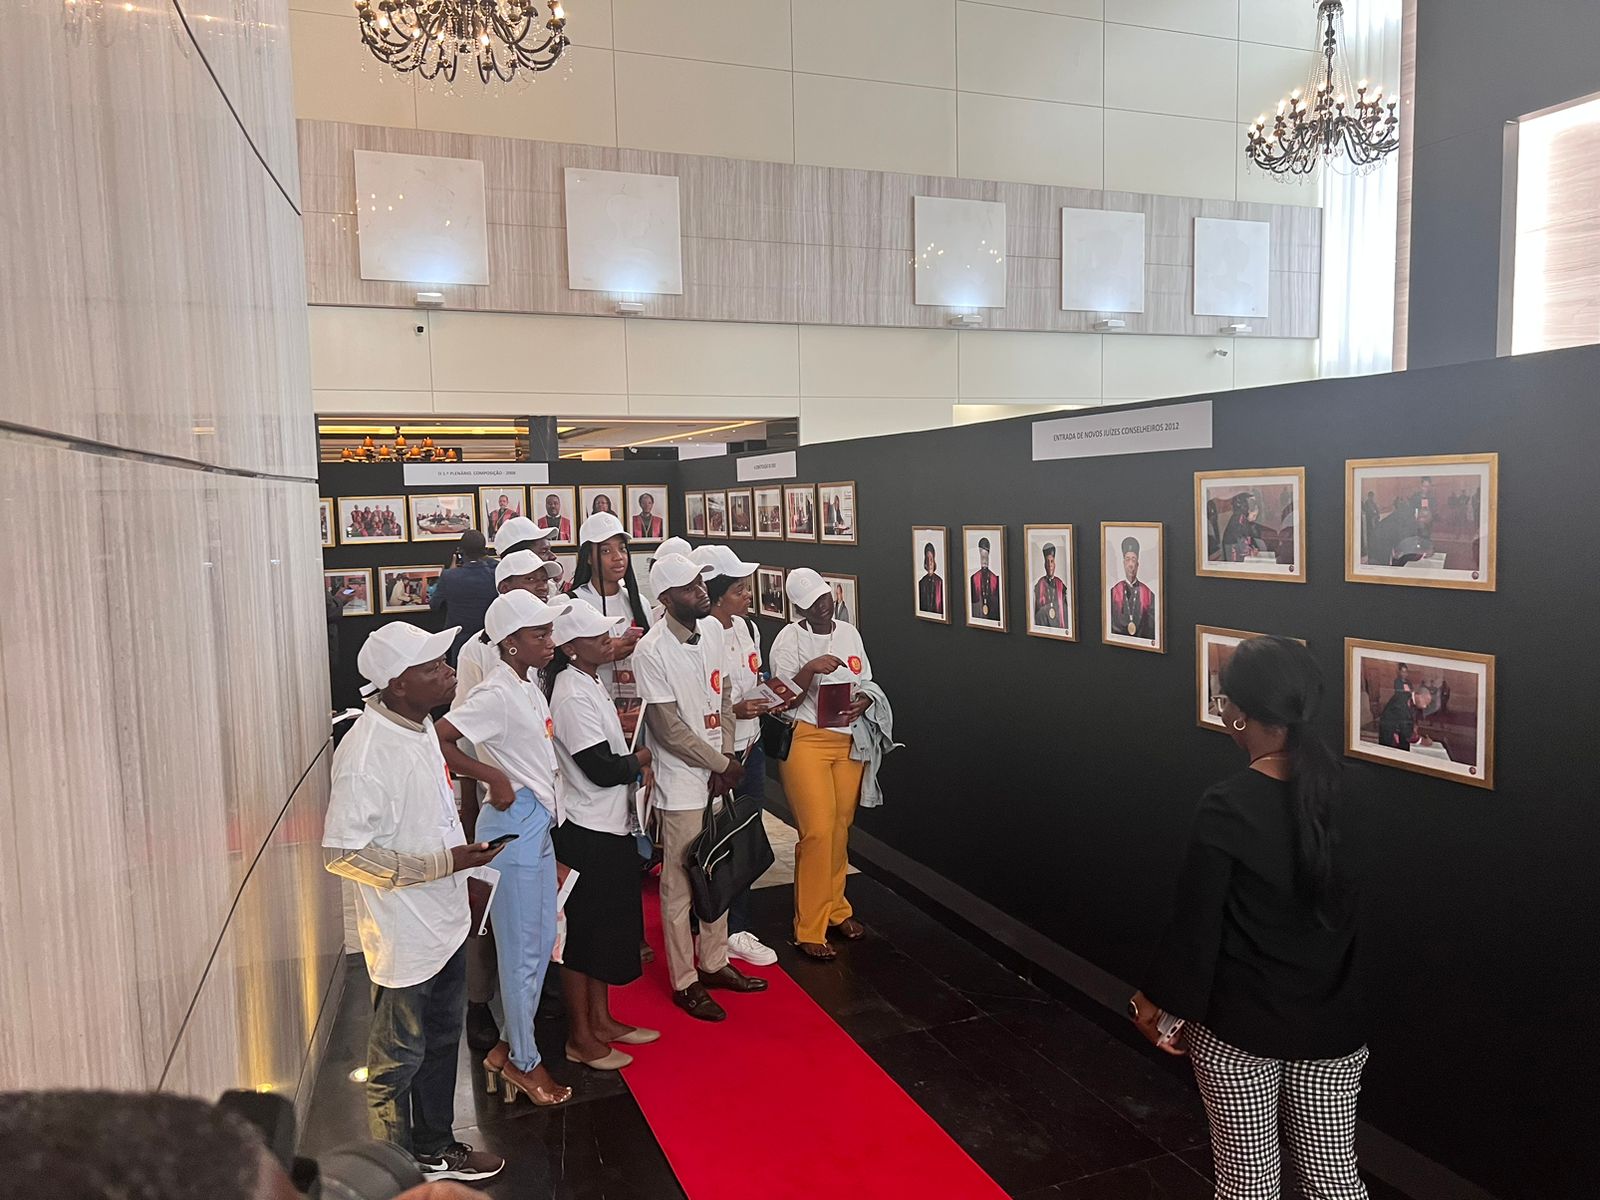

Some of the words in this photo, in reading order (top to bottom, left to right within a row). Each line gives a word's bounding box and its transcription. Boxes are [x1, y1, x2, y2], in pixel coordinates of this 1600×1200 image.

[1053, 433, 1076, 441] ENTRADA
[1085, 430, 1102, 438] NOVOS
[1103, 427, 1120, 437] JUÍZES
[1121, 424, 1164, 435] CONSELHEIROS
[1165, 422, 1179, 431] 2012
